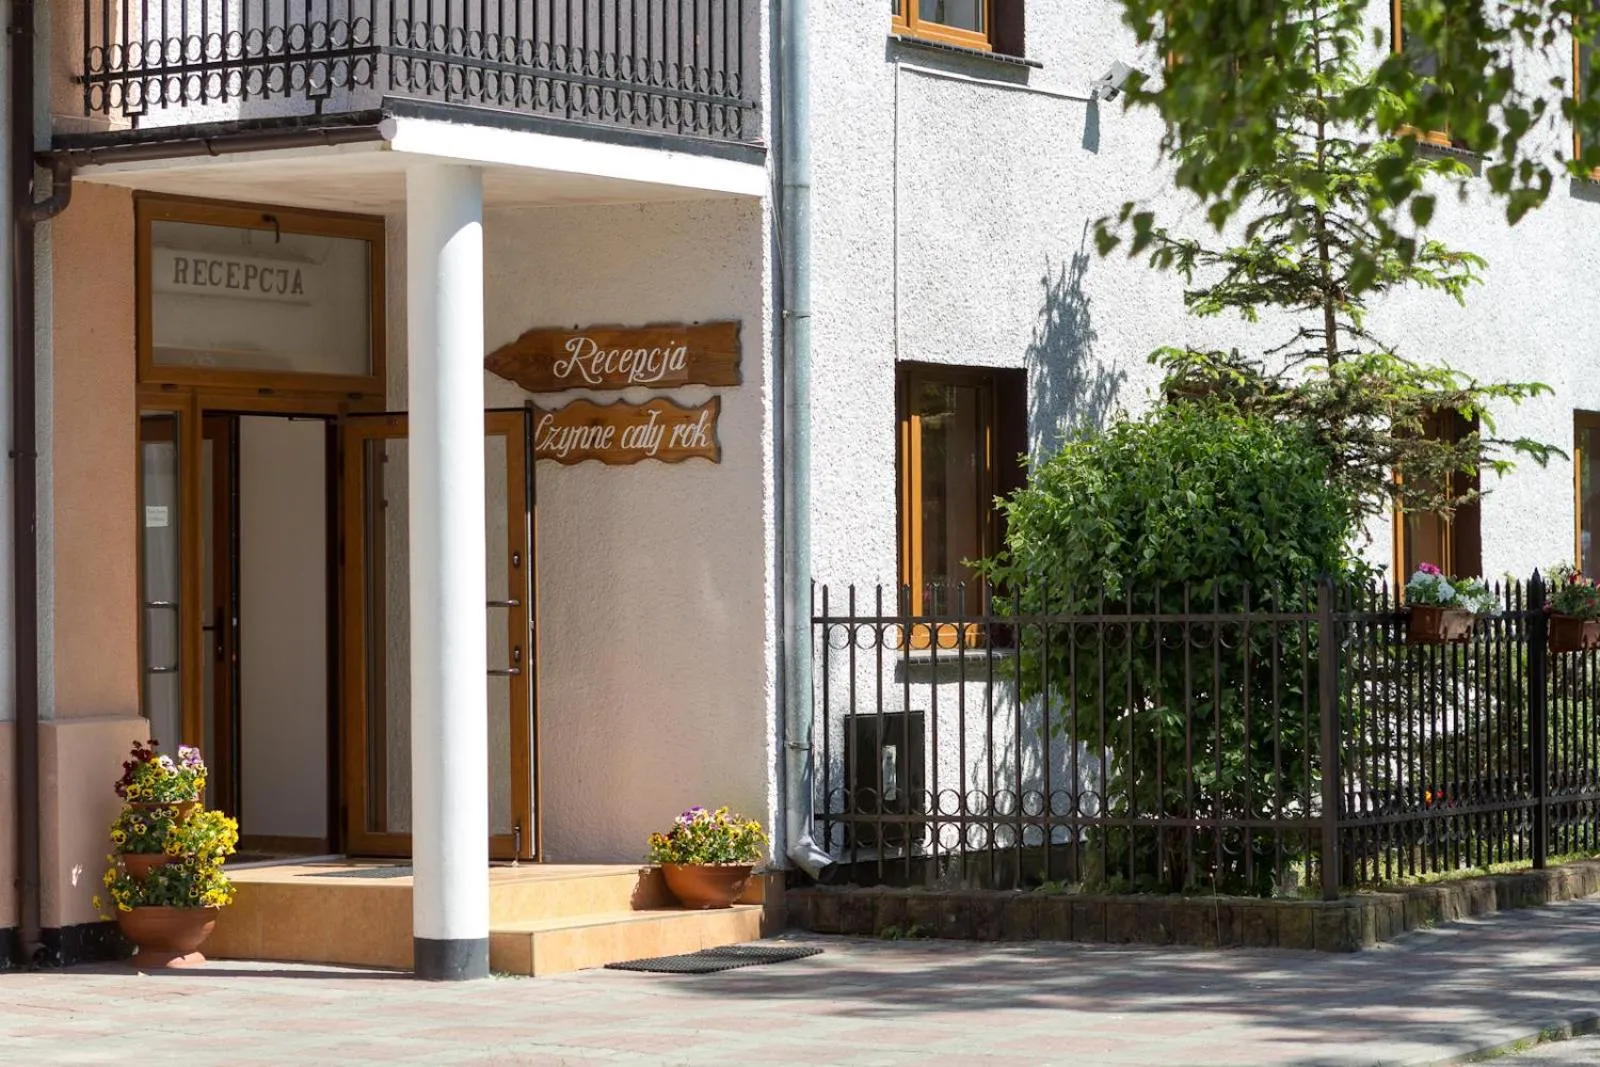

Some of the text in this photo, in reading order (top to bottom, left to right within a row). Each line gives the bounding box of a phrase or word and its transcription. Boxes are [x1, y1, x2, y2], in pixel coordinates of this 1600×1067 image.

[173, 256, 304, 295] RECEPCJA
[553, 336, 687, 384] Recepcja
[535, 409, 710, 457] Czynne cały rok
